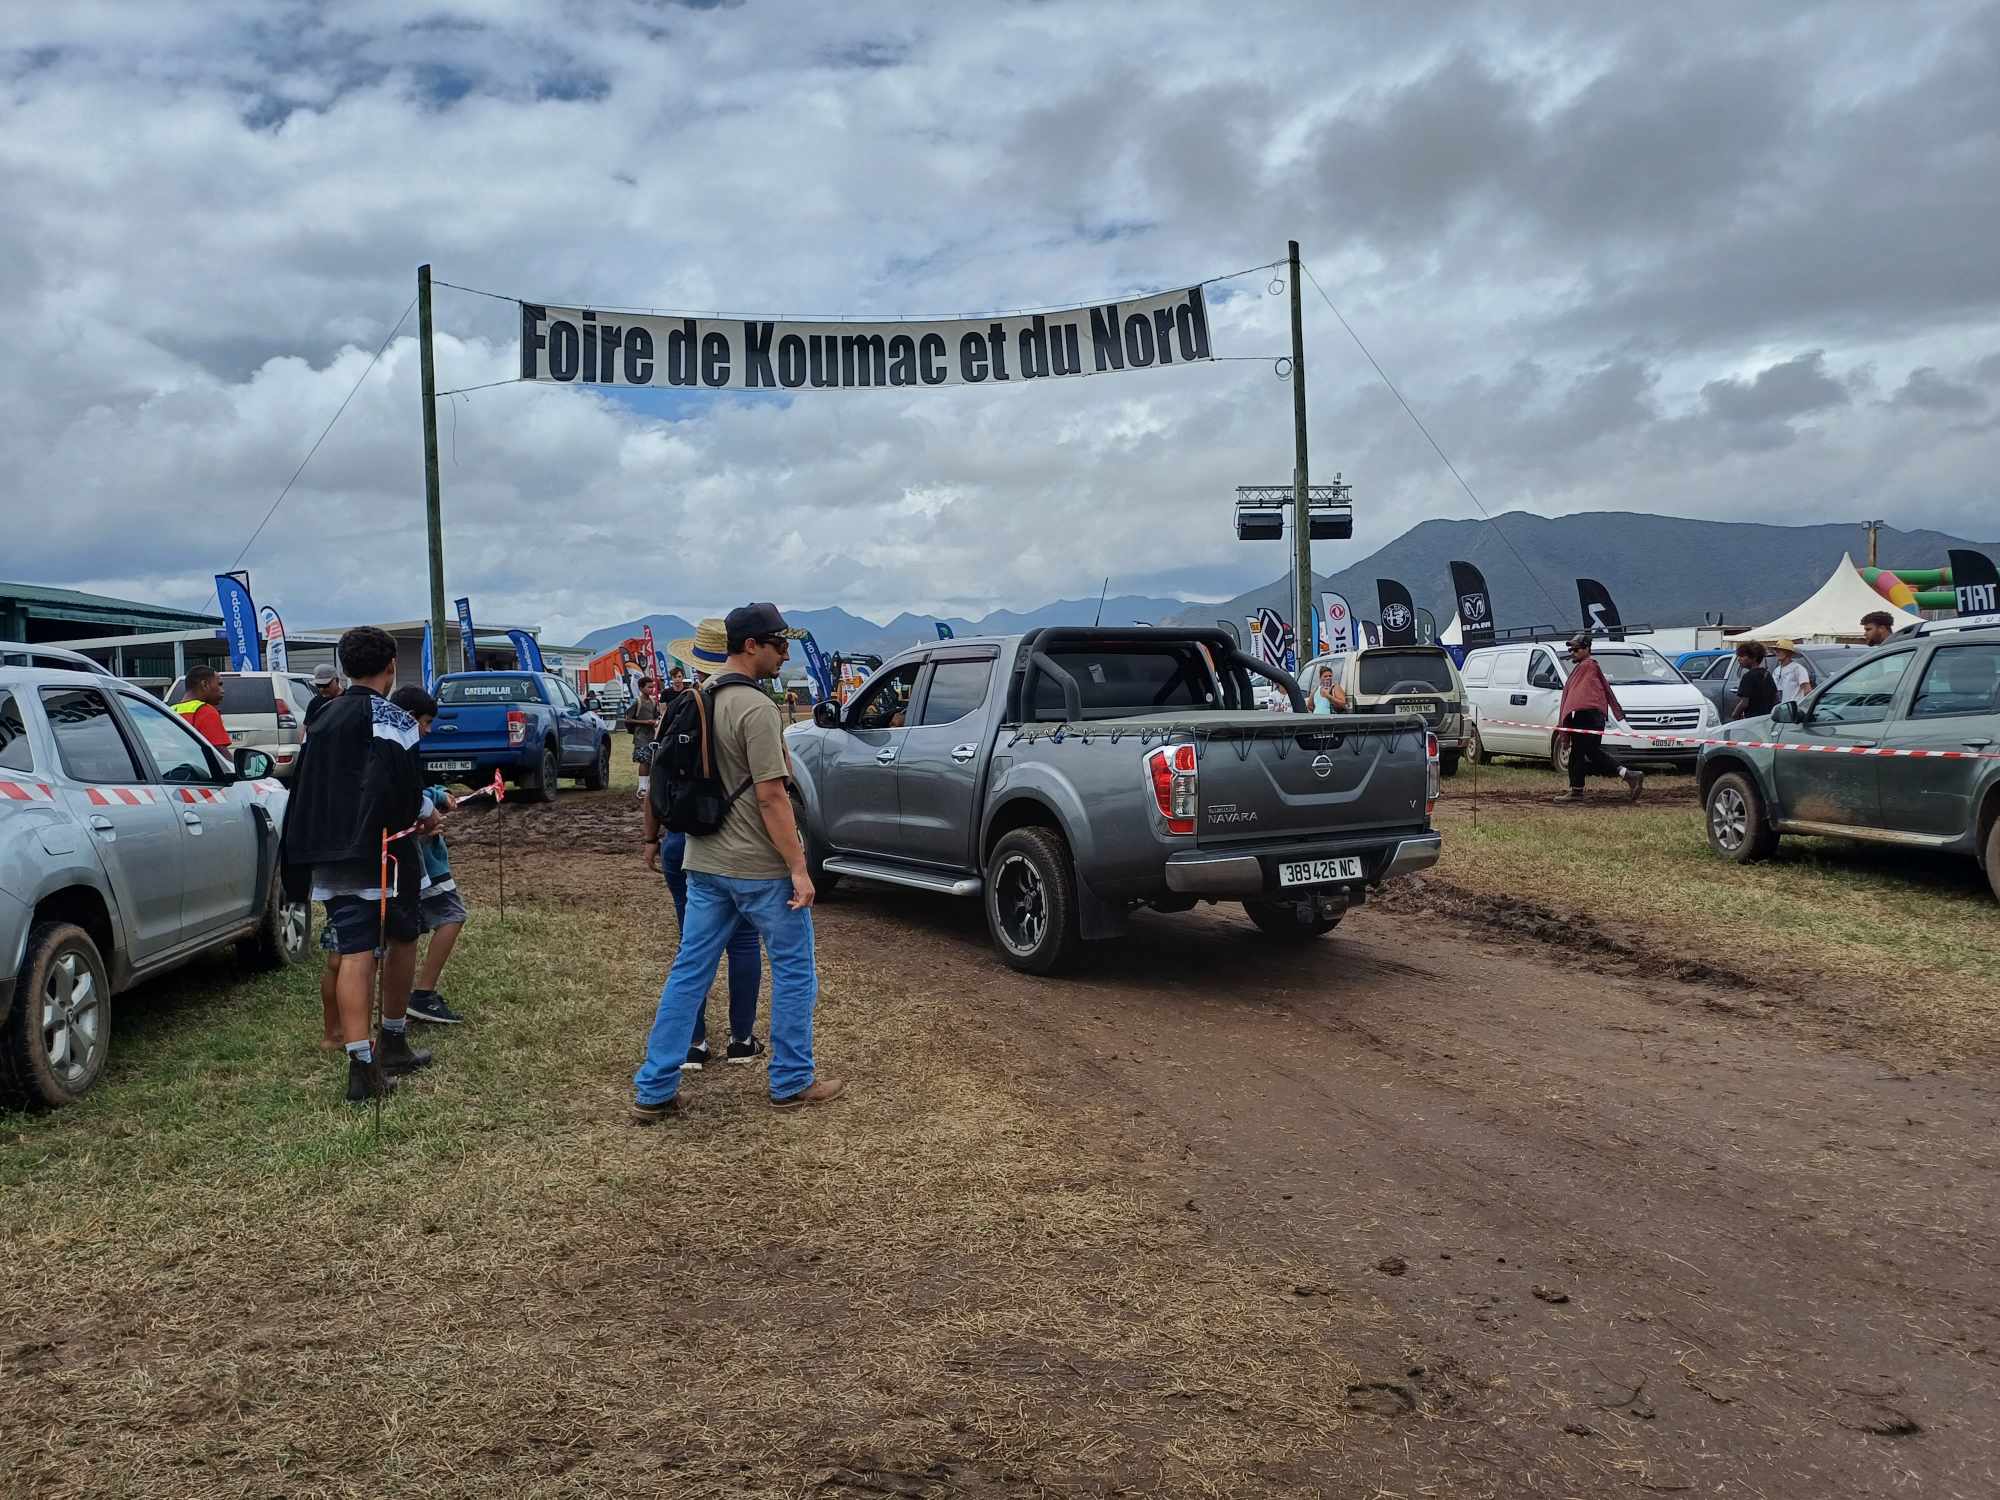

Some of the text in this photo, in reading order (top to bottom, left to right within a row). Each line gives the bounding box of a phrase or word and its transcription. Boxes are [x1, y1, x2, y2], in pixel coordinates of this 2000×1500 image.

[522, 287, 1210, 388] Foire de Koumac et du Nord
[1956, 584, 1997, 612] FIAT
[231, 590, 247, 655] BlueScope
[1462, 621, 1491, 631] RAM
[464, 686, 511, 696] CATERPILLAR
[1207, 812, 1258, 824] NAVARA
[1286, 859, 1355, 882] 389 426 NC
